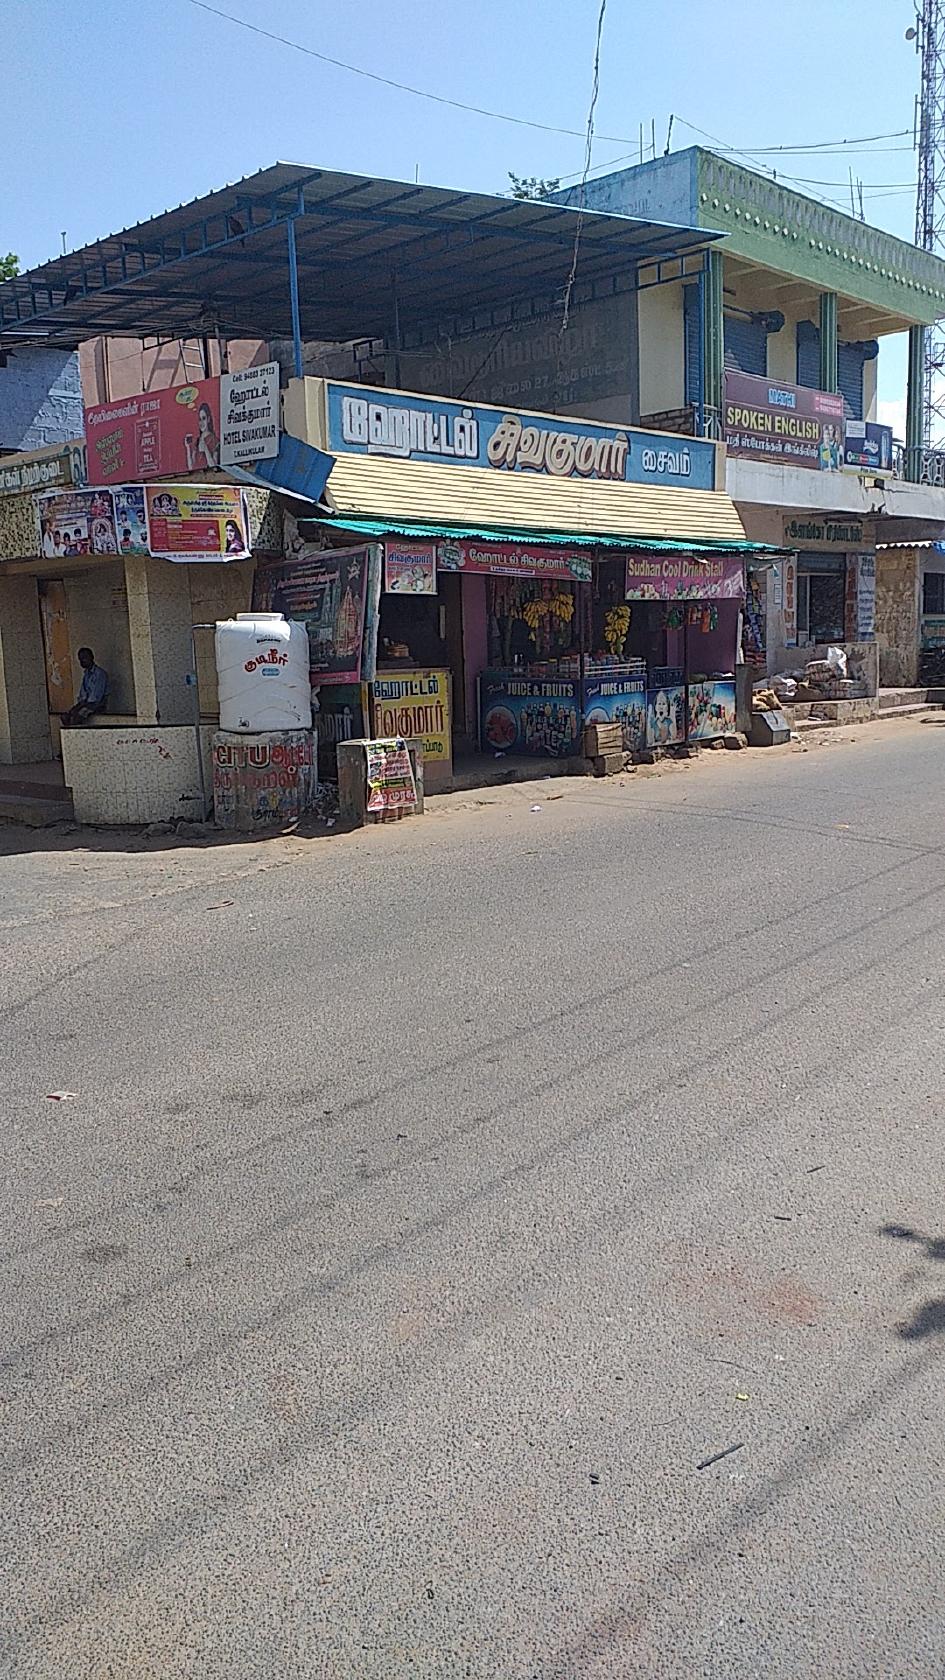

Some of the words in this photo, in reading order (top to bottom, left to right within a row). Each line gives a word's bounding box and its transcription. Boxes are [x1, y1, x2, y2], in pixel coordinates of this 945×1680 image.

[229, 379, 269, 406] ஹோட்டல்
[726, 406, 772, 432] SPOKEN
[774, 416, 819, 440] ENGLISH
[223, 430, 242, 445] HOTEL
[242, 425, 276, 443] SIVAKUMAR
[342, 394, 479, 458] ஹோட்டல்
[486, 414, 630, 481] சிவகுமார்
[641, 446, 692, 477] சைவம்
[468, 549, 520, 567] ஹோட்டல்
[520, 553, 566, 569] சிவகுமார்
[628, 558, 661, 577] Sudhan
[662, 560, 681, 577] Cool
[682, 561, 704, 577] Drink
[705, 560, 724, 577] Stall
[374, 675, 439, 700] ஹோட்டல்
[507, 682, 532, 696] JUICE
[533, 683, 540, 696] &
[541, 682, 575, 697] FRUITS
[600, 682, 618, 696] JUICE
[618, 683, 623, 694] &
[623, 680, 645, 694] FRUITS
